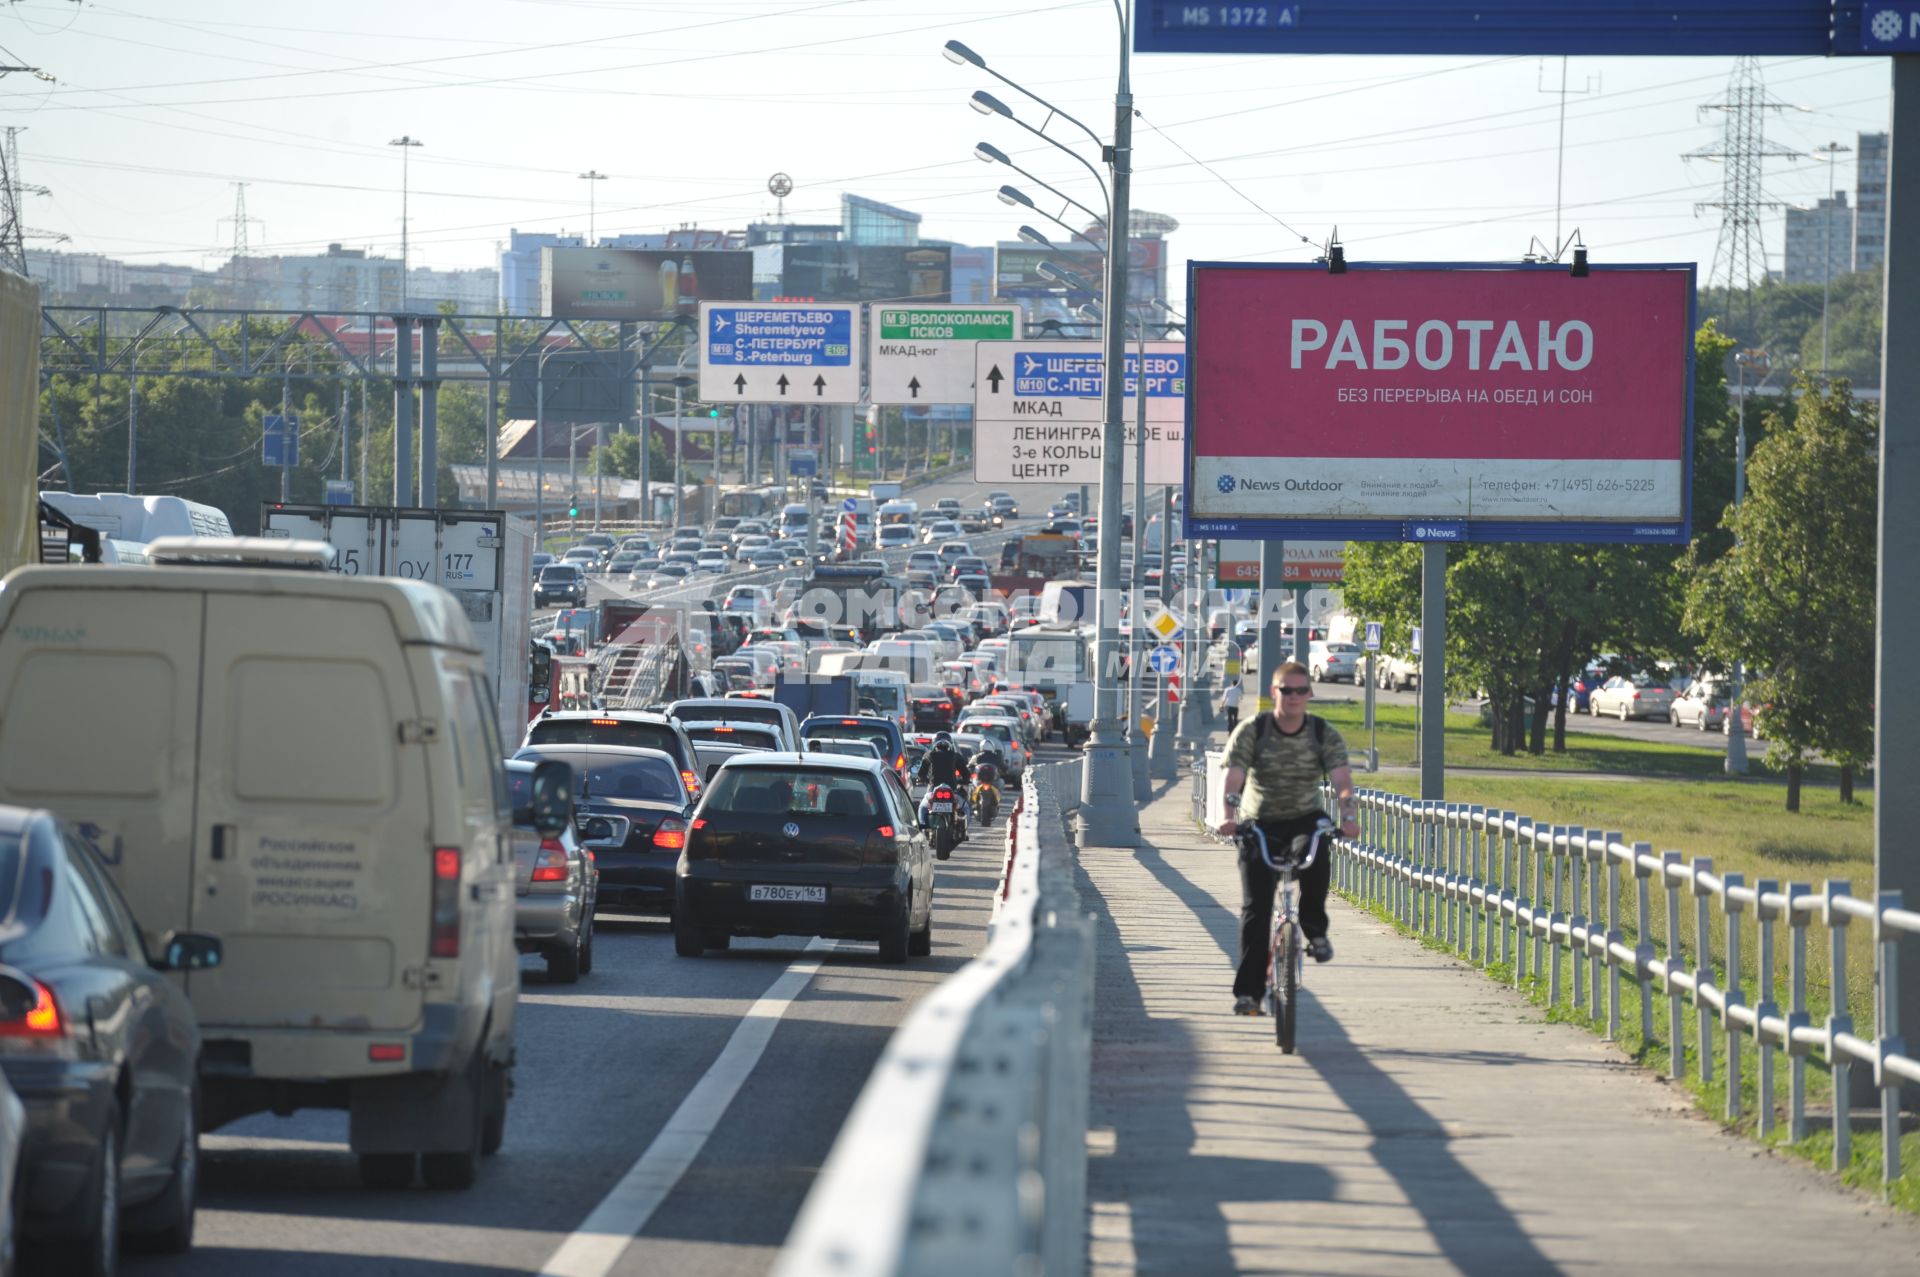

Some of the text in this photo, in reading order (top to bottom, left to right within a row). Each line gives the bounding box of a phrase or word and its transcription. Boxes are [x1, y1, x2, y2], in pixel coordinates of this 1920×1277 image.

[1183, 6, 1210, 26] MS
[1220, 7, 1267, 26] 1372
[735, 312, 833, 324] ШЕРЕМЕТЬЕВО
[911, 313, 1009, 326] ВОЛОКОЛАМСК
[735, 324, 826, 337] Sheremetyevo
[910, 326, 953, 338] ПСКОВ
[735, 339, 824, 350] С.-ПЕТЕРБУРГ
[880, 345, 937, 357] МКАД-юг
[1290, 319, 1593, 371] РАБОТАЮ
[735, 351, 812, 364] S.-Peterburg
[1338, 388, 1592, 405] БЕЗ ПЕРЕРЫВА НА ОБЕД И СОН
[1013, 401, 1062, 417] МКАД
[1167, 430, 1184, 441] ш.
[1012, 445, 1101, 460] 3-е КОЛЬЦ
[1012, 463, 1069, 479] ЦЕНТР
[1240, 478, 1343, 492] News Outdoor
[1544, 479, 1559, 491] +7
[1596, 479, 1655, 492] 626-5225
[1427, 528, 1456, 538] News
[444, 553, 474, 570] 177
[446, 571, 463, 580] RUS
[754, 886, 822, 899] В780ЕУ 161
